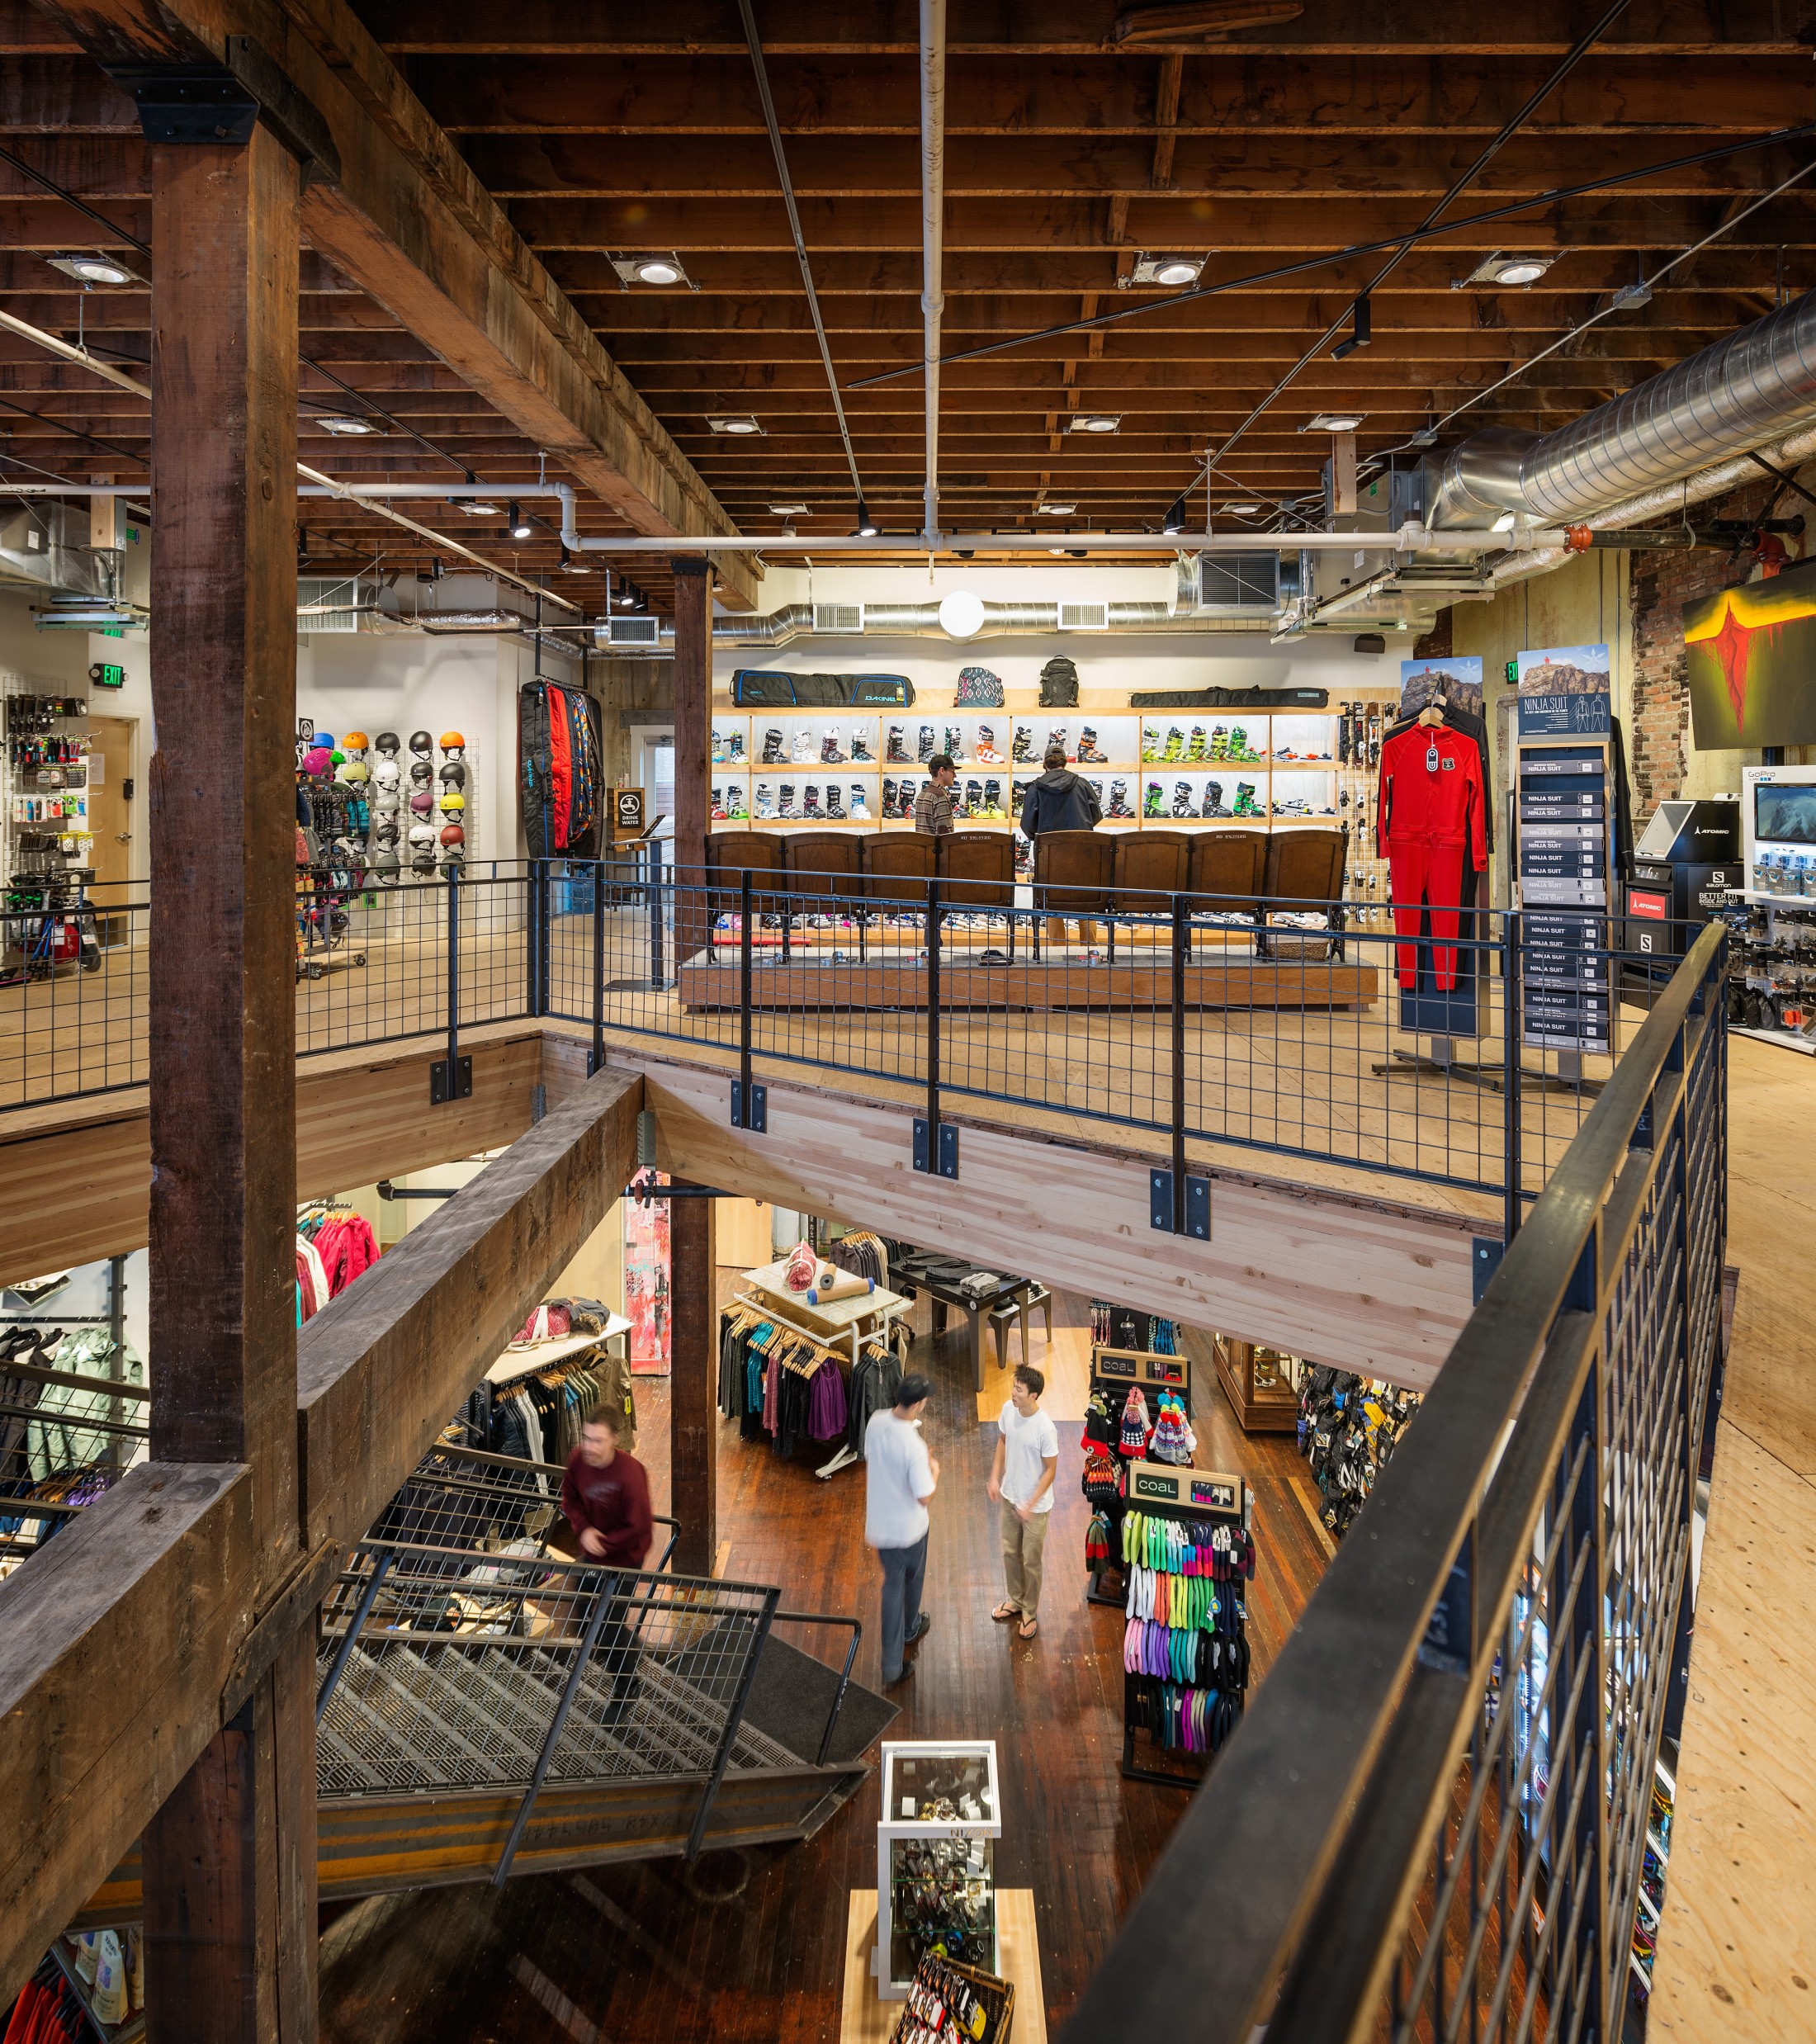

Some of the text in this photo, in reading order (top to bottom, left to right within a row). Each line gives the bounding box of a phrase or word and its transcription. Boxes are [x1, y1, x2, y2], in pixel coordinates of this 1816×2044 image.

[104, 665, 121, 685] EXIT
[1525, 697, 1568, 710] NINJA SUIT
[951, 1828, 992, 1838] NIXON
